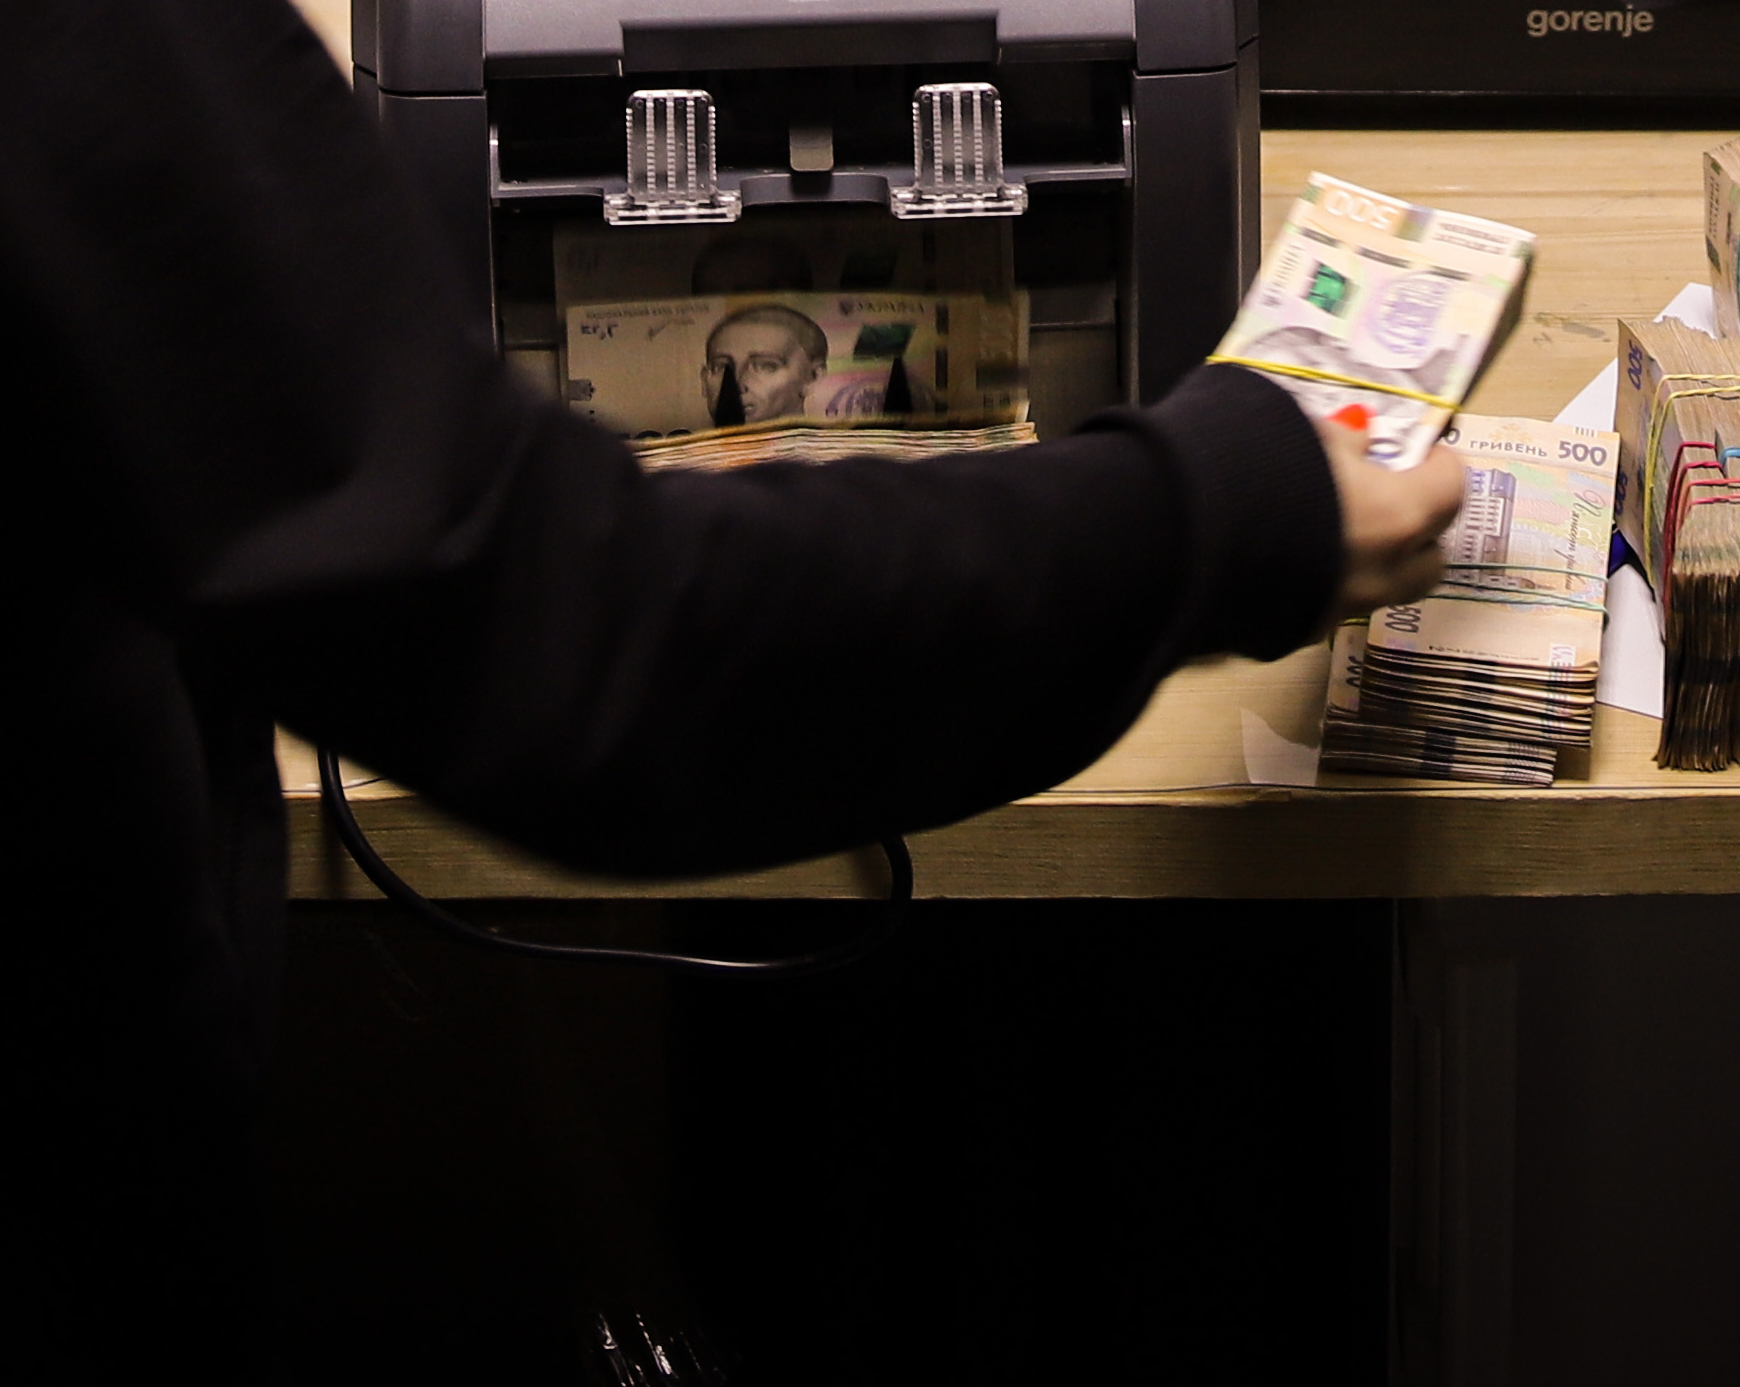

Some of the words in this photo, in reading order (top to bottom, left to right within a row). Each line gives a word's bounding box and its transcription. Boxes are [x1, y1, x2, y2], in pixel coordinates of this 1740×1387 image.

[1527, 4, 1653, 37] gorenje
[1627, 339, 1643, 390] 500
[1469, 440, 1549, 458] ГРИВЕНЬ
[1558, 440, 1608, 467] 500
